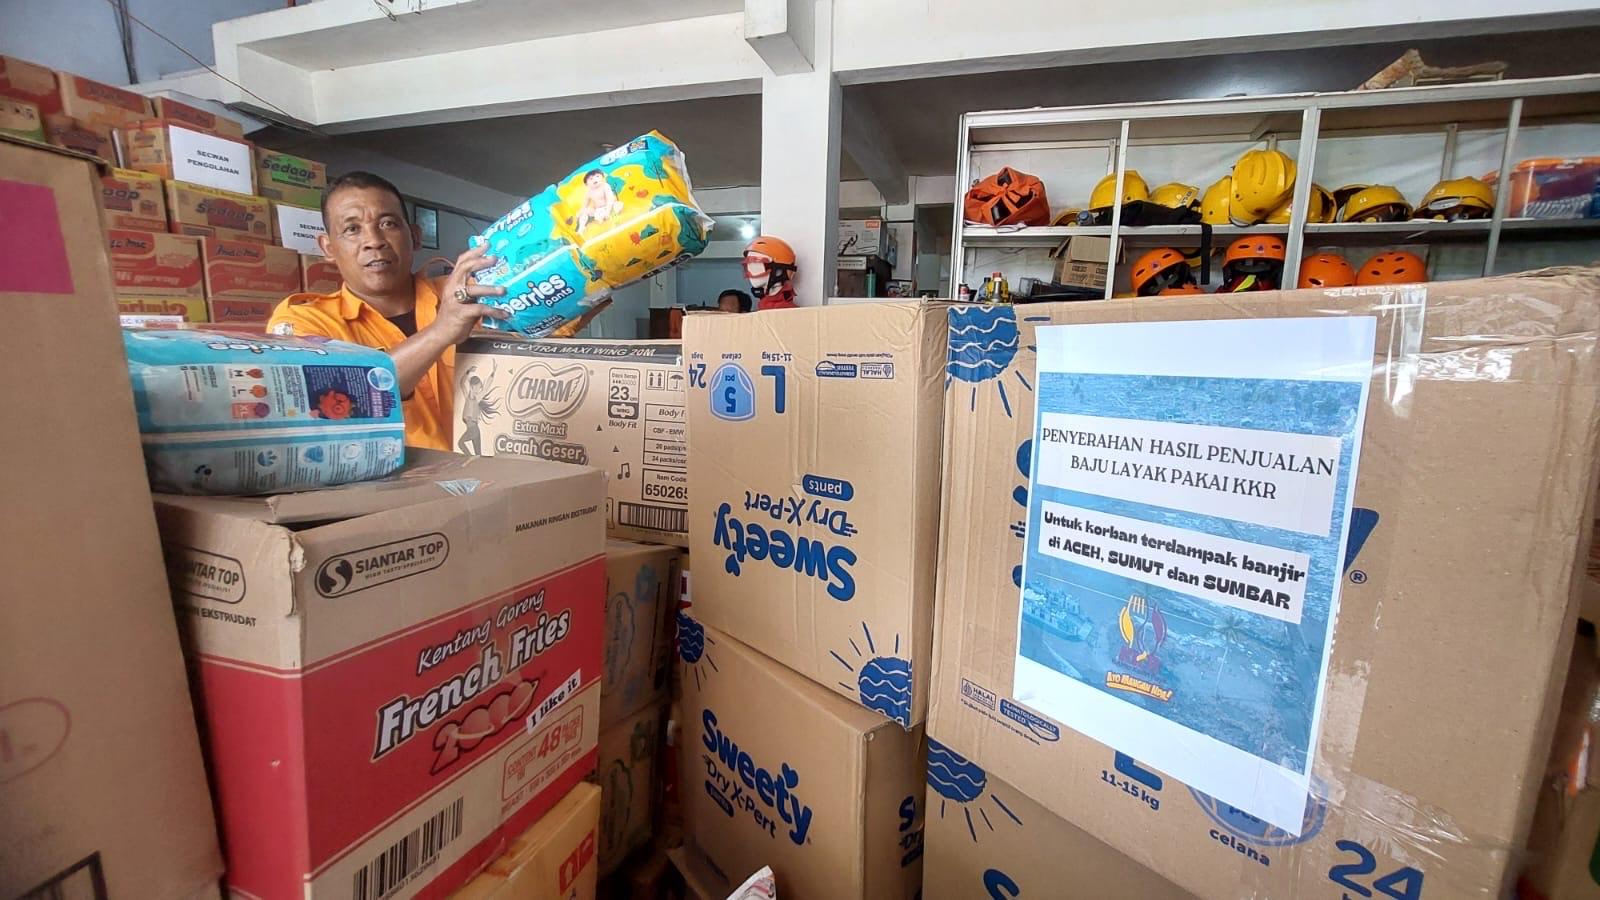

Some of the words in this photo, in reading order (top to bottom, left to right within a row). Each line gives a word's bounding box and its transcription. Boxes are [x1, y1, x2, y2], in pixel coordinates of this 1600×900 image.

[187, 158, 240, 175] PENGOLAHAN
[196, 150, 229, 163] SECWAN
[261, 158, 317, 180] Sedaap
[103, 188, 140, 201] aap
[293, 231, 317, 240] PENGOL
[545, 287, 575, 307] pants
[559, 346, 592, 355] MAXI
[593, 347, 627, 356] WING
[629, 348, 656, 357] 20M
[761, 351, 771, 361] kg
[771, 353, 792, 361] 11-15
[517, 375, 574, 404] CHARM
[688, 363, 707, 388] 24
[761, 365, 785, 413] L
[611, 386, 630, 401] 23
[724, 387, 737, 412] 5
[609, 420, 626, 429] Body
[627, 421, 637, 429] Fit
[659, 408, 681, 419] Body
[514, 420, 539, 433] Extra
[541, 423, 566, 437] Maxi
[496, 437, 538, 457] Cegah
[541, 439, 587, 465] Geser,
[1042, 427, 1144, 454] PENYERAHAN
[1149, 439, 1202, 460] HASIL
[1206, 445, 1335, 477] PENJUALAN
[808, 479, 842, 495] pants
[1070, 455, 1109, 474] BAJU
[1111, 460, 1167, 483] LAYAK
[1170, 468, 1228, 493] PAKAI
[1233, 477, 1277, 500] KKR
[515, 518, 548, 533] MAKANAN
[548, 512, 571, 524] RINGAN
[570, 505, 598, 519] EKSTRUDAT
[744, 490, 806, 526] X-Pert
[806, 499, 852, 536] Dry
[355, 547, 415, 574] SIANTAR
[418, 541, 444, 557] TOP
[713, 502, 858, 602] Sweety
[1044, 510, 1083, 532] Untuk
[1085, 519, 1138, 546] korban
[1141, 531, 1239, 568] terdampak
[1242, 554, 1306, 583] banjir
[192, 560, 217, 581] NTAR
[218, 567, 240, 587] TOP
[1048, 535, 1061, 551] di
[1062, 540, 1105, 564] ACEH,
[1107, 549, 1165, 576] SUMUT
[1167, 565, 1200, 587] dan
[1203, 574, 1292, 610] SUMBAR
[201, 606, 257, 628] EKSTRUDAT
[416, 618, 491, 677] Kentang
[496, 588, 546, 628] Goreng
[371, 645, 501, 761] French
[507, 609, 571, 671] Fries
[539, 688, 567, 721] like
[567, 677, 580, 695] it
[972, 687, 994, 702] HALAL
[1002, 708, 1027, 725] TESTED
[538, 725, 562, 758] 48
[702, 709, 812, 846] Sweety
[1101, 769, 1140, 798] 11-15
[1141, 791, 1161, 811] kg
[705, 757, 730, 793] Dry
[731, 780, 776, 839] X-Pert
[1209, 828, 1271, 867] celana
[1328, 839, 1425, 900] 24
